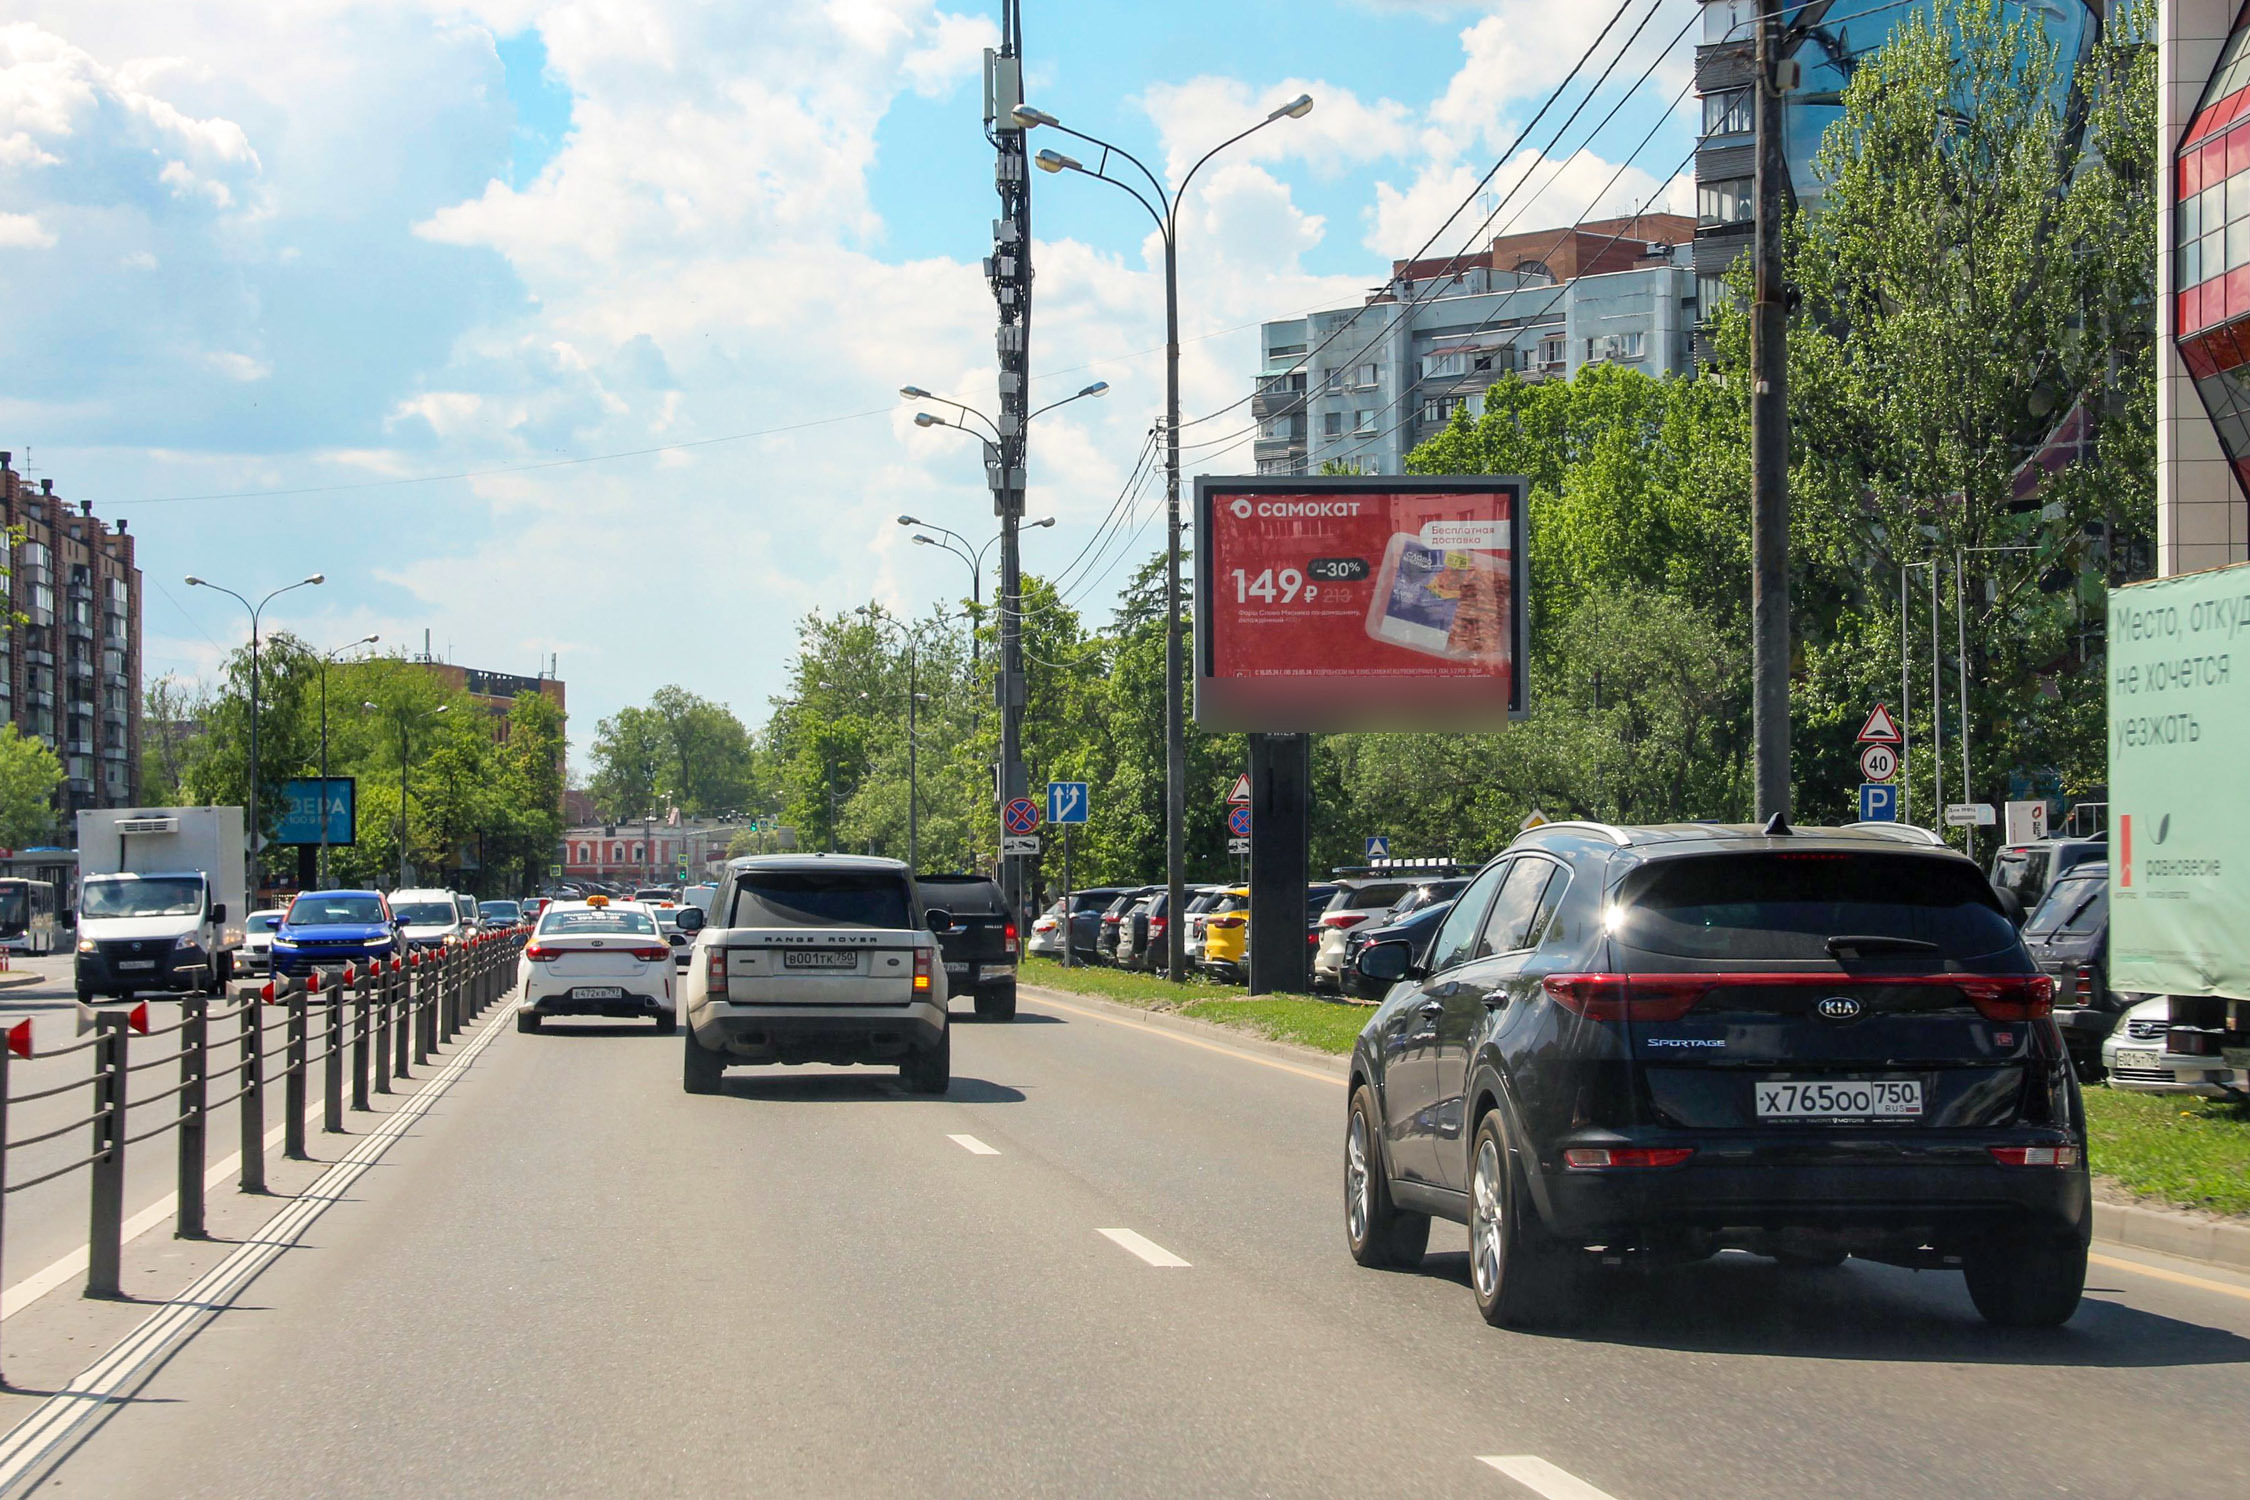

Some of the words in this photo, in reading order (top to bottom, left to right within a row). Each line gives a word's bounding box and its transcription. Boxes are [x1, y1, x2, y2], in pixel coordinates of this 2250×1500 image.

[1431, 525, 1495, 535] Бесплатная
[1431, 536, 1481, 545] доставка
[2116, 606, 2182, 643] Место,
[2116, 665, 2138, 695] не
[2145, 654, 2230, 692] хочется
[2115, 713, 2200, 760] уезжать
[1869, 756, 1888, 772] 40
[1868, 789, 1888, 818] P
[2146, 859, 2220, 883] равновесие
[1825, 1001, 1854, 1014] KIA
[1648, 1038, 1726, 1048] SPORTAGE
[1874, 1083, 1915, 1104] 750
